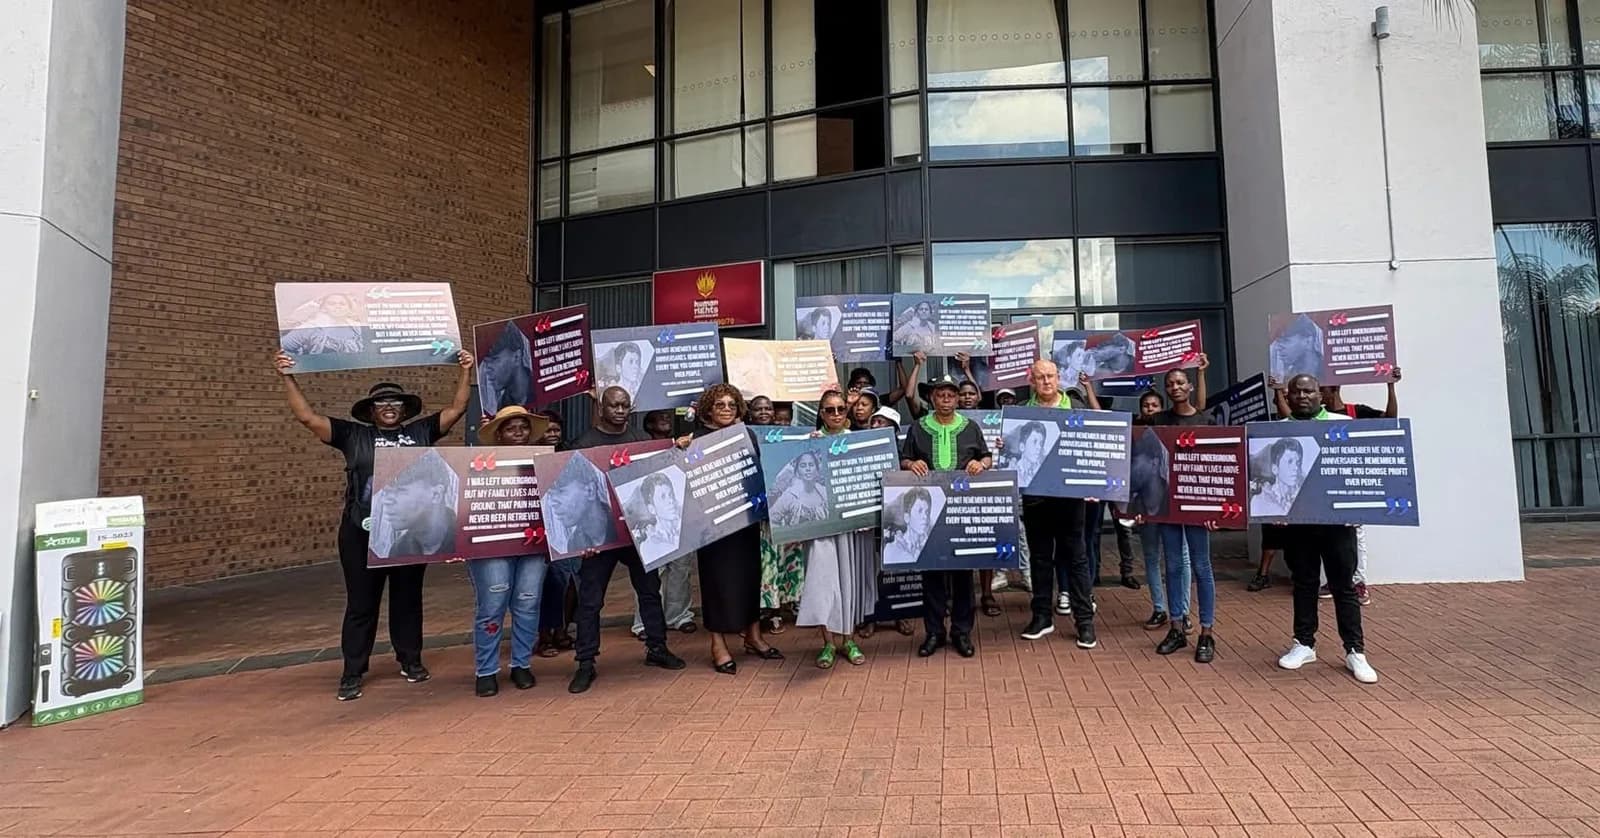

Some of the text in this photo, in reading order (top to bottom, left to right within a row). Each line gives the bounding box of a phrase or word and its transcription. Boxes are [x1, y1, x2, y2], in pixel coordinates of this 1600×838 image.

[694, 306, 718, 315] rights
[1191, 464, 1207, 473] FAMILY
[1209, 465, 1221, 473] LIVES
[1223, 466, 1239, 474] ABOVE
[467, 477, 470, 486] I
[471, 477, 484, 486] WAS
[486, 477, 500, 485] LEFT
[464, 488, 540, 498] BUT MY FAMILY LIVES ABO
[1177, 486, 1192, 494] NEVER
[1194, 486, 1206, 495] BEEN
[498, 501, 512, 510] THAT
[513, 501, 527, 509] PAIN
[528, 500, 540, 508] HAS
[469, 514, 489, 524] NEVER
[490, 513, 506, 522] BEEN
